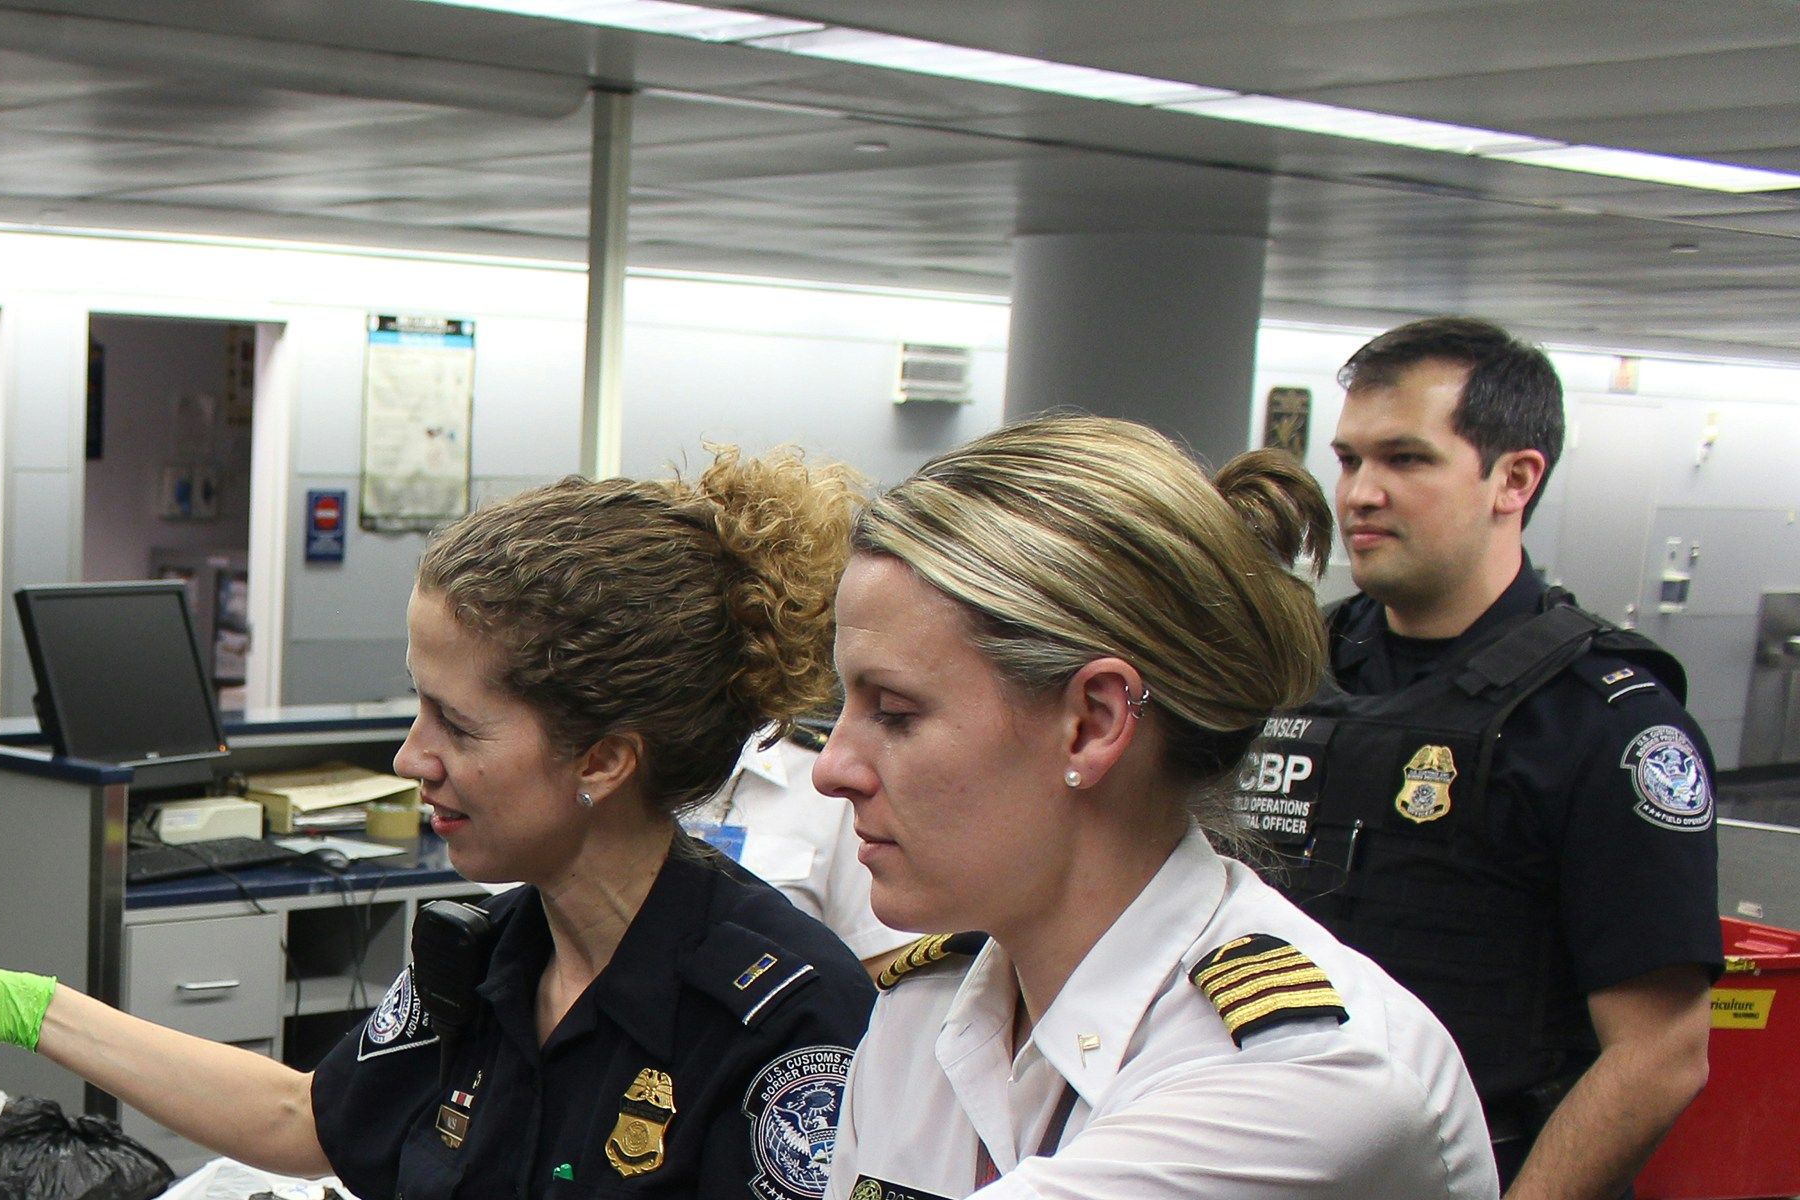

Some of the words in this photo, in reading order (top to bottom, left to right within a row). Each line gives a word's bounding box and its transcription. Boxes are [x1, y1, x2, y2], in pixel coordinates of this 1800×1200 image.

[1262, 717, 1312, 739] ENSLEY
[1240, 752, 1313, 793] CBP
[1250, 797, 1311, 817] OPERATIONS
[1262, 814, 1307, 834] OFFICER
[1661, 812, 1682, 825] FIELD
[1711, 997, 1755, 1011] riculture
[764, 1066, 786, 1084] U.S.
[786, 1052, 841, 1070] CUSTOMS
[760, 1068, 801, 1102] BORDER
[802, 1062, 850, 1076] PROTEC
